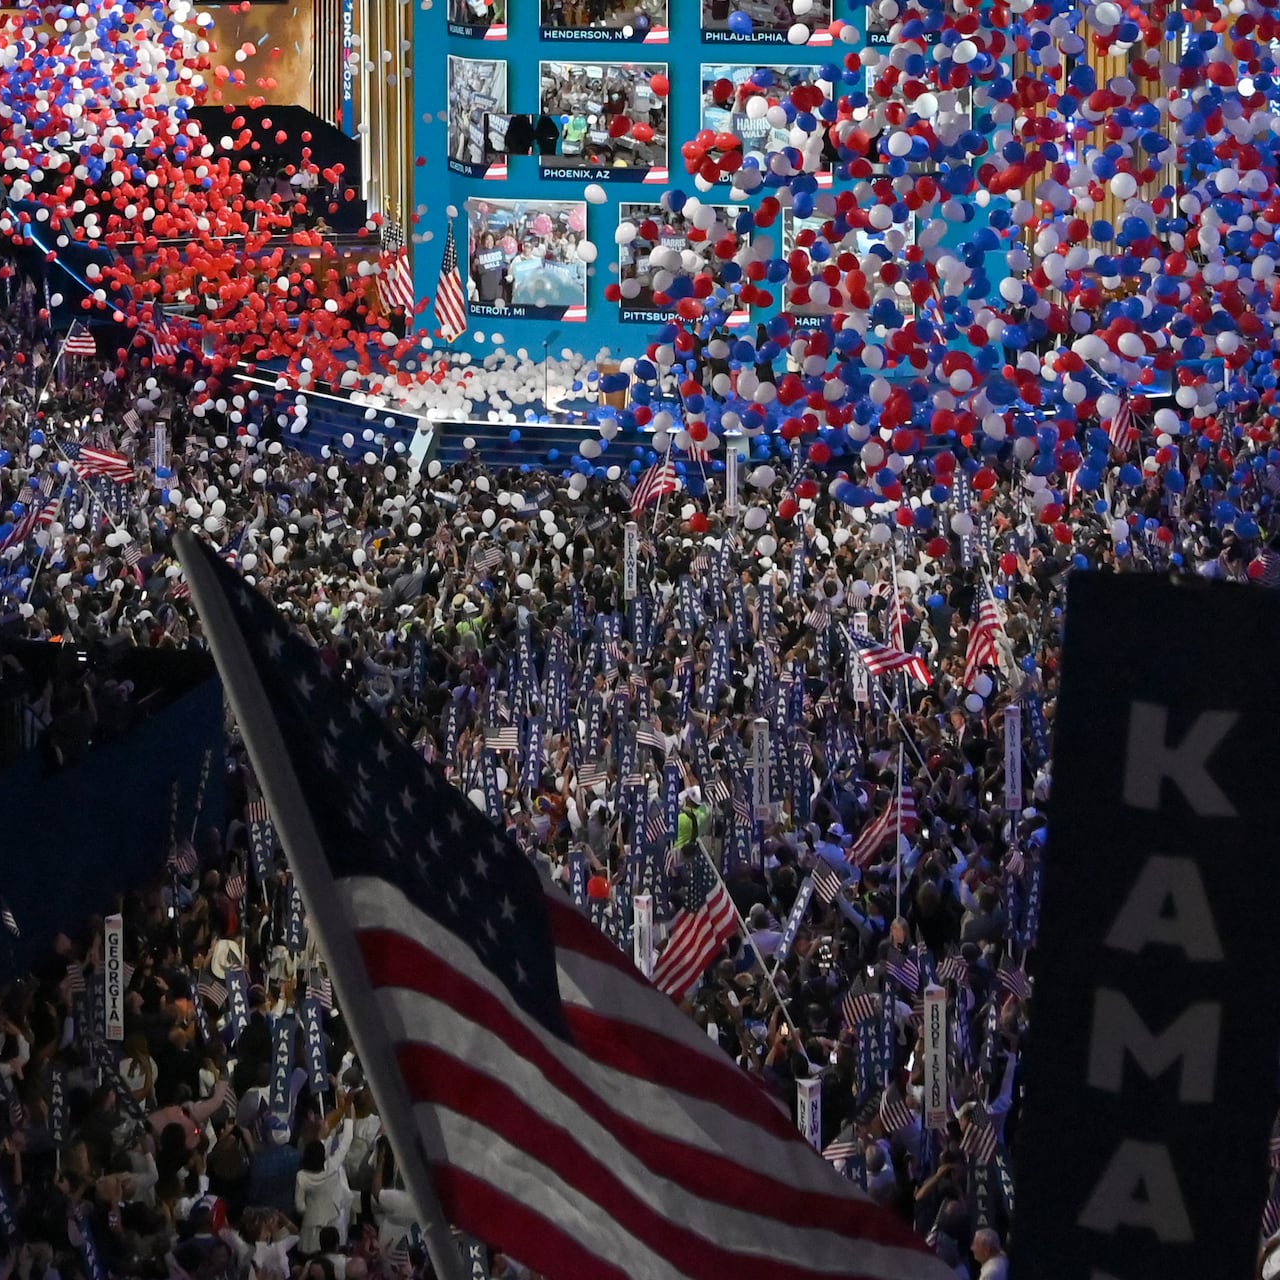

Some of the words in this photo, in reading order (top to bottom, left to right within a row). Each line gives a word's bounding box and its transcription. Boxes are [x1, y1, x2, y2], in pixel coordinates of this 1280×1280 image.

[543, 29, 613, 41] HENDERSON,
[705, 32, 787, 44] PHILADELPHIA,
[543, 169, 594, 180] PHOENIX,
[596, 170, 611, 180] AZ
[470, 304, 511, 317] DETROIT,
[513, 307, 526, 316] MI
[626, 532, 635, 589] DELAWARE
[635, 601, 644, 651] KAMALA
[681, 577, 692, 630] KAMALA
[732, 591, 744, 638] KAMALA
[705, 651, 719, 705] KAMALA
[447, 706, 458, 762] KAMALA
[529, 724, 541, 784] KAMALA
[589, 703, 601, 758] KAMALA
[484, 756, 500, 819] KAMALA
[669, 772, 678, 834] KAMALA
[793, 756, 801, 819] KAMALA
[636, 793, 645, 856] KAMALA
[291, 890, 301, 944] AMALA
[775, 886, 813, 955] KAMALA
[108, 934, 120, 1022] GEORGIA
[1077, 701, 1242, 1280] KAMA
[307, 1007, 324, 1084] KAMALA
[882, 980, 893, 1061] KAMALA
[276, 1028, 290, 1103] KAMALA
[931, 1054, 941, 1108] ISLAND
[52, 1071, 63, 1144] KAMALA
[975, 1159, 988, 1227] MALA
